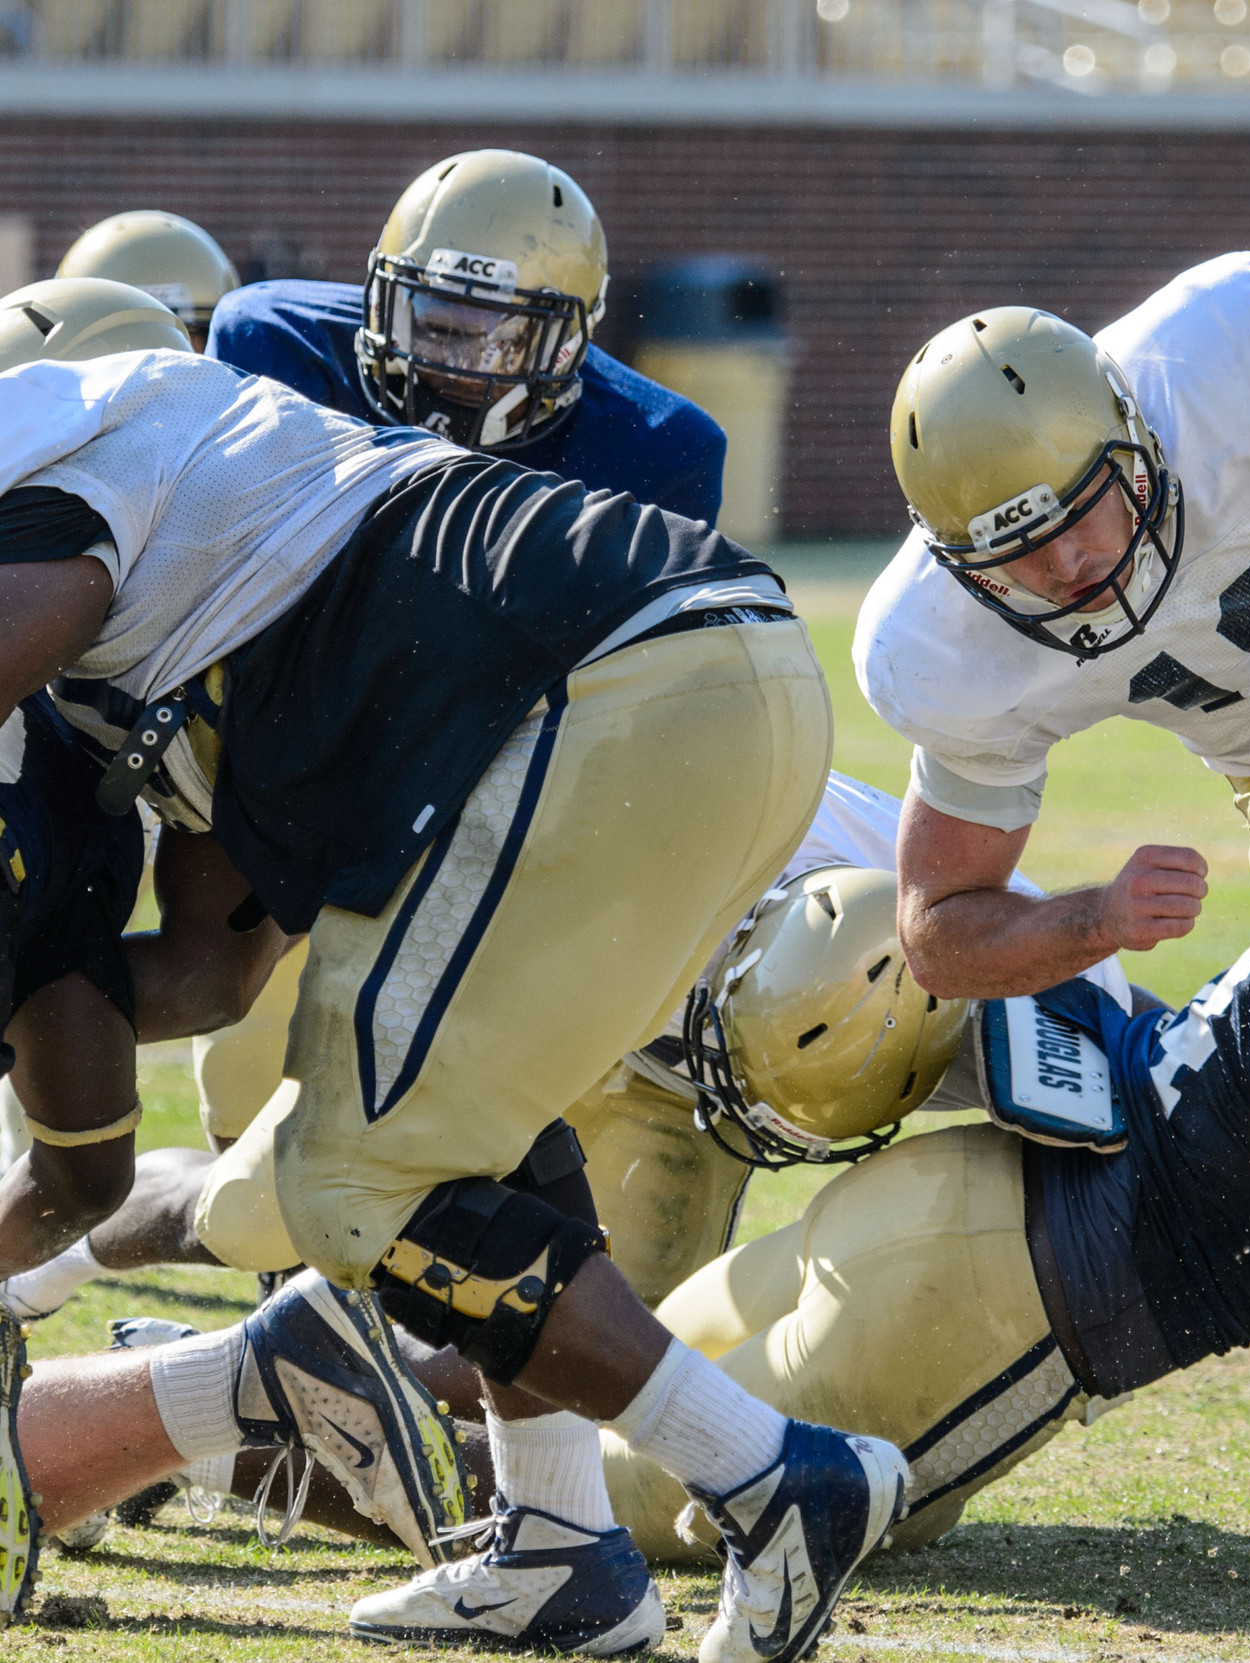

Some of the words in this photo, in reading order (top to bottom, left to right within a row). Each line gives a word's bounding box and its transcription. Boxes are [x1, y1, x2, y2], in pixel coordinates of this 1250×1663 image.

[454, 256, 496, 277] ACC
[1134, 474, 1147, 527] Rdell
[993, 498, 1033, 532] ACC
[967, 571, 1010, 596] iddell
[1070, 623, 1098, 649] R
